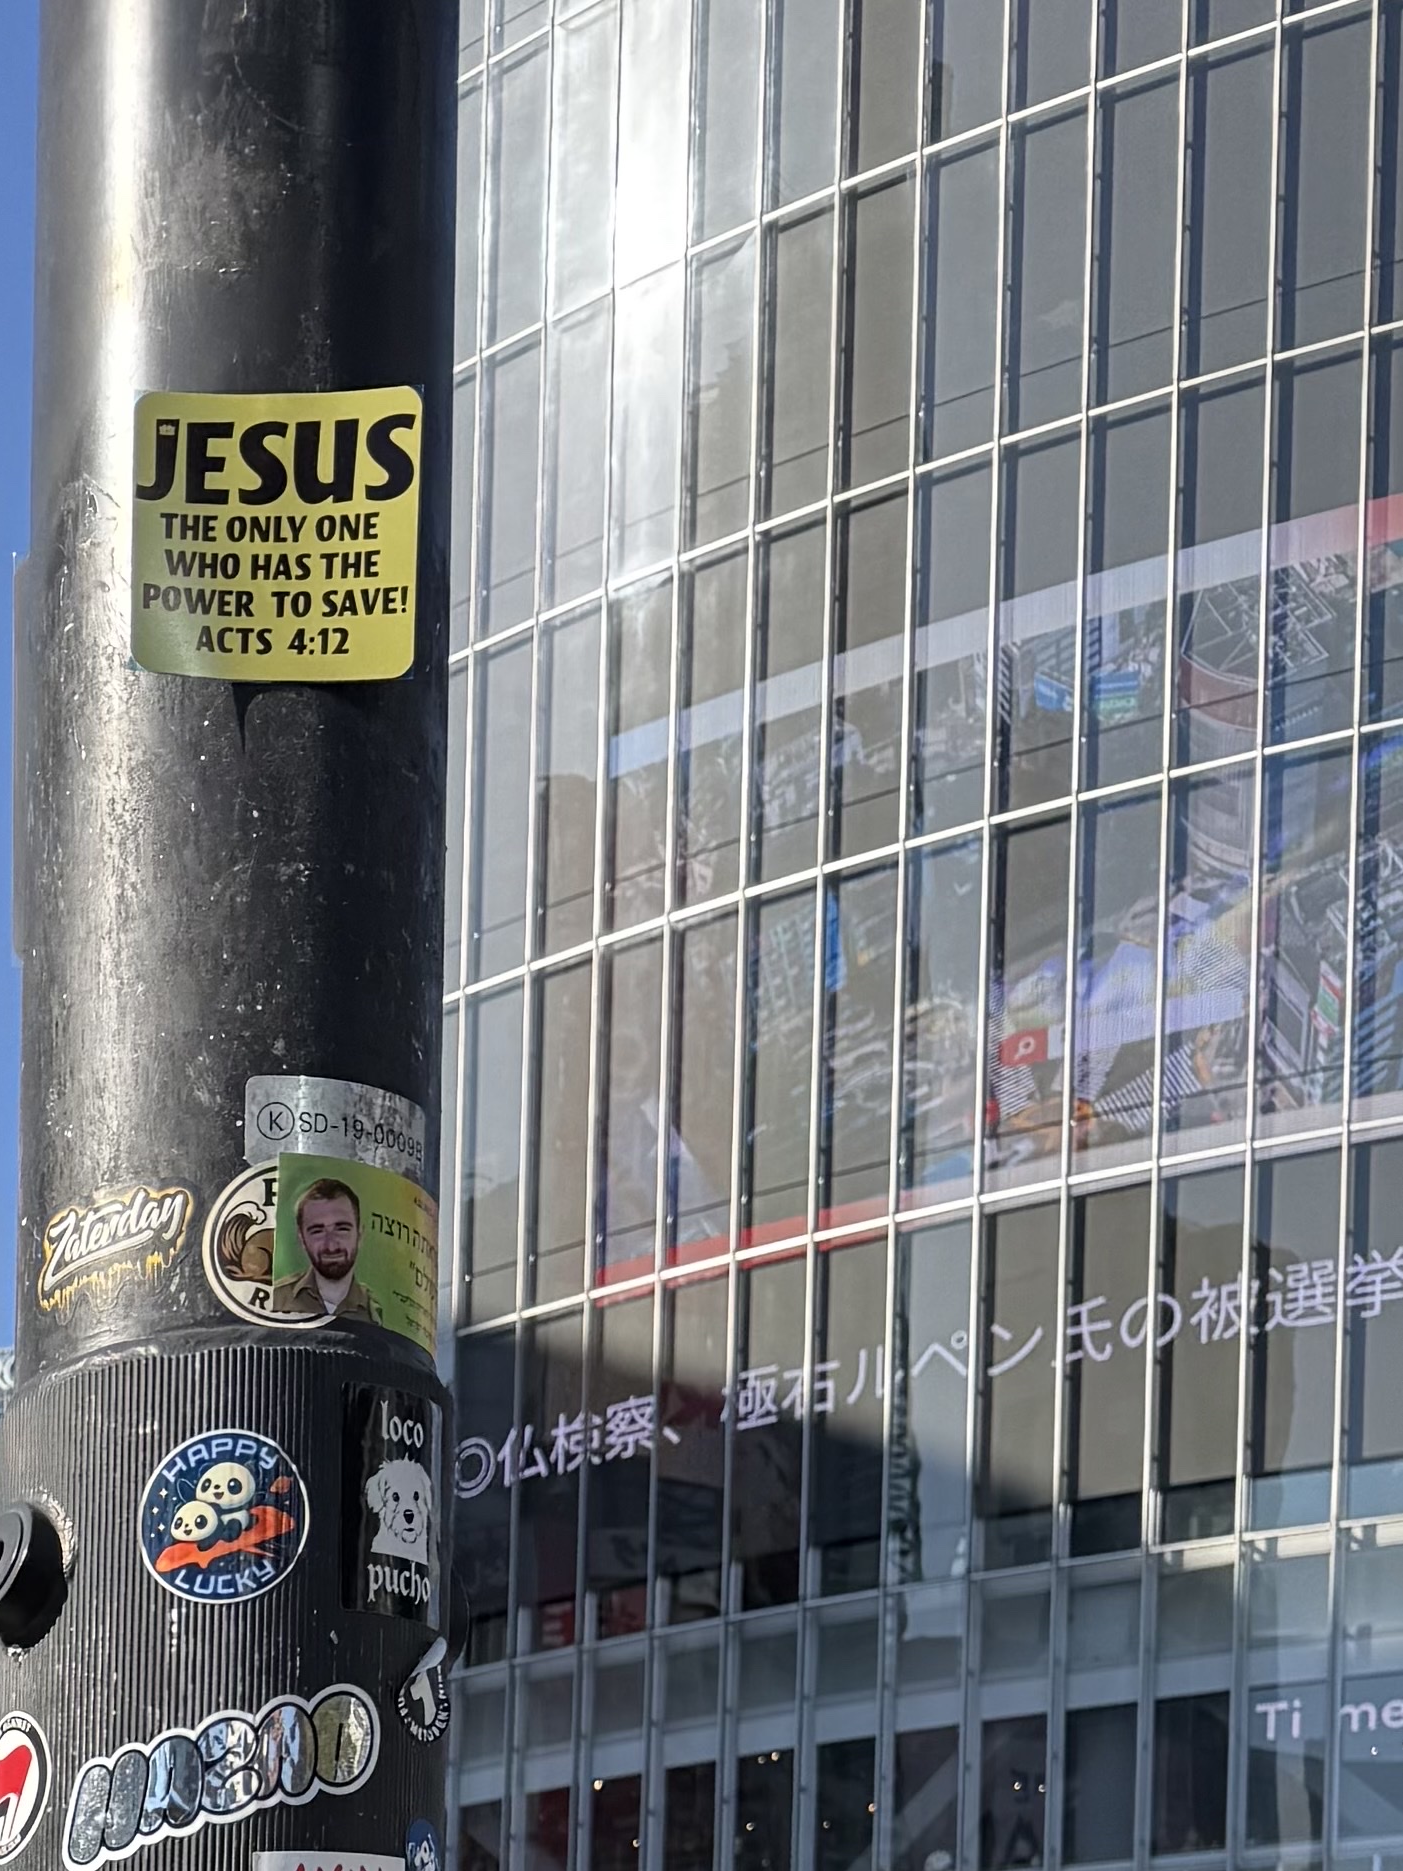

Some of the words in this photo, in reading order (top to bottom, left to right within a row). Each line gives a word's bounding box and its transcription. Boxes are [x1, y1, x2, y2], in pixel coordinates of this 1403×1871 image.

[135, 413, 416, 505] JESUS
[160, 513, 218, 541] THE
[226, 515, 307, 542] ONLY
[315, 512, 380, 540] ONE
[164, 549, 240, 579] WHO
[251, 553, 311, 580] HAS
[320, 550, 380, 579] THE
[143, 583, 254, 617] POWER
[271, 591, 311, 617] TO
[322, 586, 408, 617] SAVE!
[196, 626, 272, 655] ACTS
[287, 628, 349, 655] 4:12
[380, 1400, 425, 1451] loco
[161, 1437, 279, 1483] HAPPY
[173, 1559, 276, 1596] LUCKY
[367, 1560, 432, 1605] pucho
